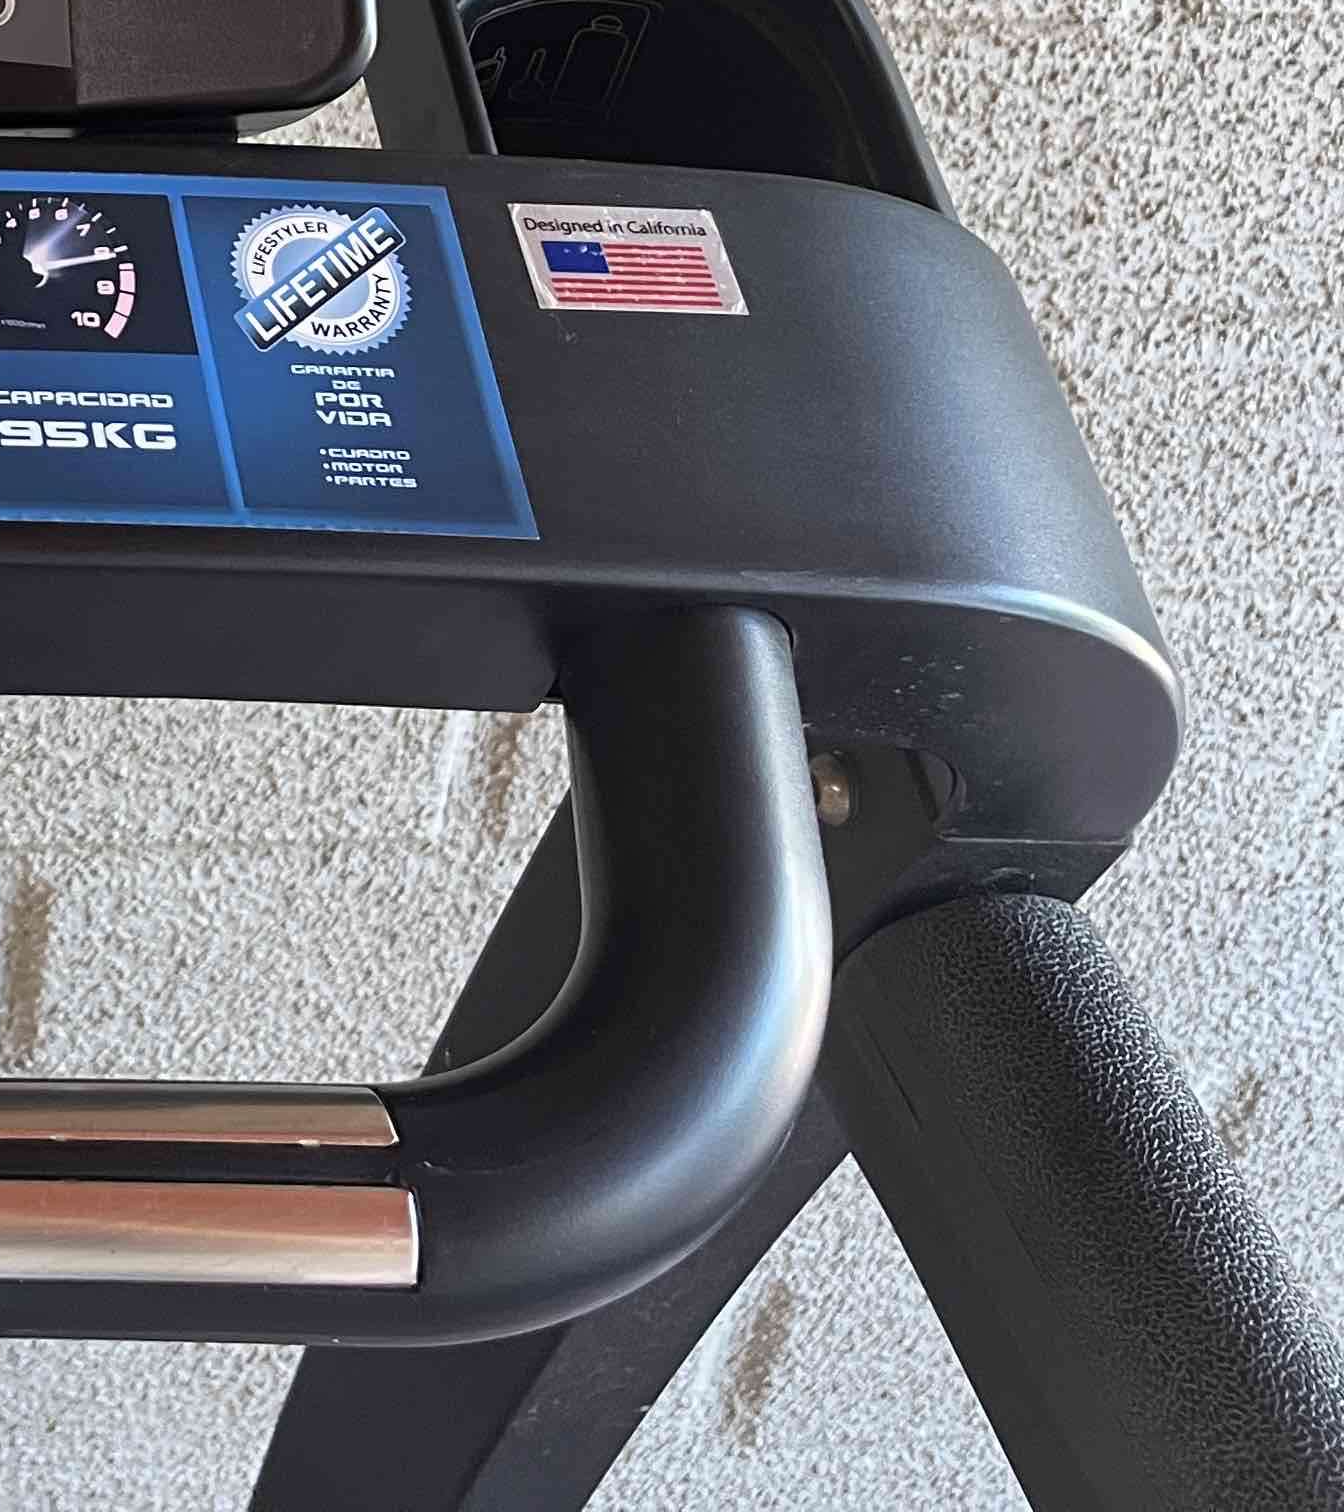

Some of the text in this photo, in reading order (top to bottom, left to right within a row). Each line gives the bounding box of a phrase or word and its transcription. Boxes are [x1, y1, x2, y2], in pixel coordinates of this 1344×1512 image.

[5, 218, 17, 229] 4
[76, 223, 91, 236] 7
[523, 217, 707, 237] Designed in California
[252, 221, 329, 276] LIFESTYLER
[245, 217, 395, 342] LIFETIME
[311, 273, 392, 338] WARRANTY
[70, 311, 101, 328] 10
[290, 364, 395, 378] GARANTIA
[332, 380, 362, 390] DE
[315, 392, 384, 408] POR
[316, 409, 392, 427] VIDA
